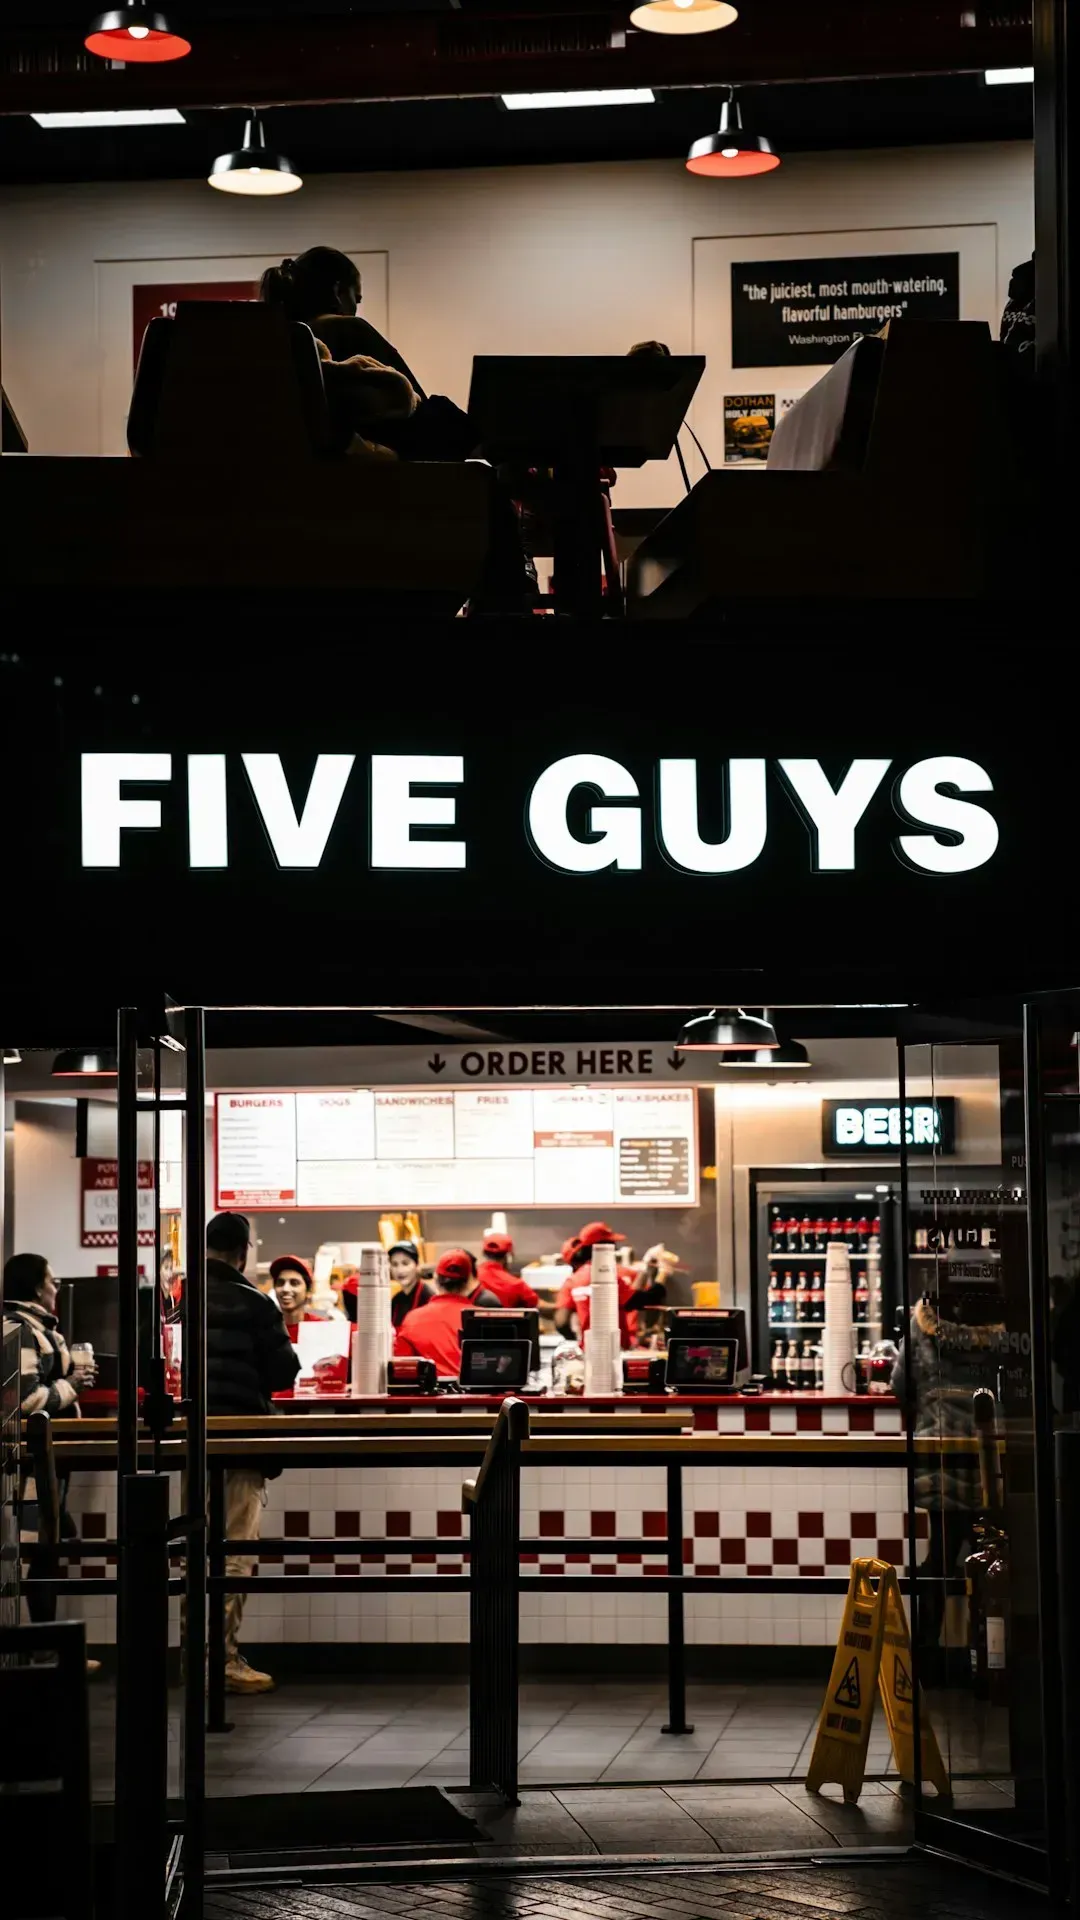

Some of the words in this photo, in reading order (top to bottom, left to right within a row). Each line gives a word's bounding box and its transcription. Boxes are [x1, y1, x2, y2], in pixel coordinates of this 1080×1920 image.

[743, 284, 768, 301] "the
[770, 282, 816, 303] juiciest,
[819, 280, 848, 298] most
[782, 305, 830, 323] flavorful
[788, 333, 850, 346] Washington
[725, 396, 774, 408] DOTHAN
[80, 753, 466, 868] FIVE
[528, 754, 1000, 872] GUYS
[460, 1051, 566, 1076] ORDER
[576, 1050, 653, 1075] HERE
[229, 1098, 284, 1108] BURGERS
[376, 1096, 456, 1106] SANDWICHES
[476, 1095, 509, 1105] FRIES
[835, 1106, 940, 1145] BEER
